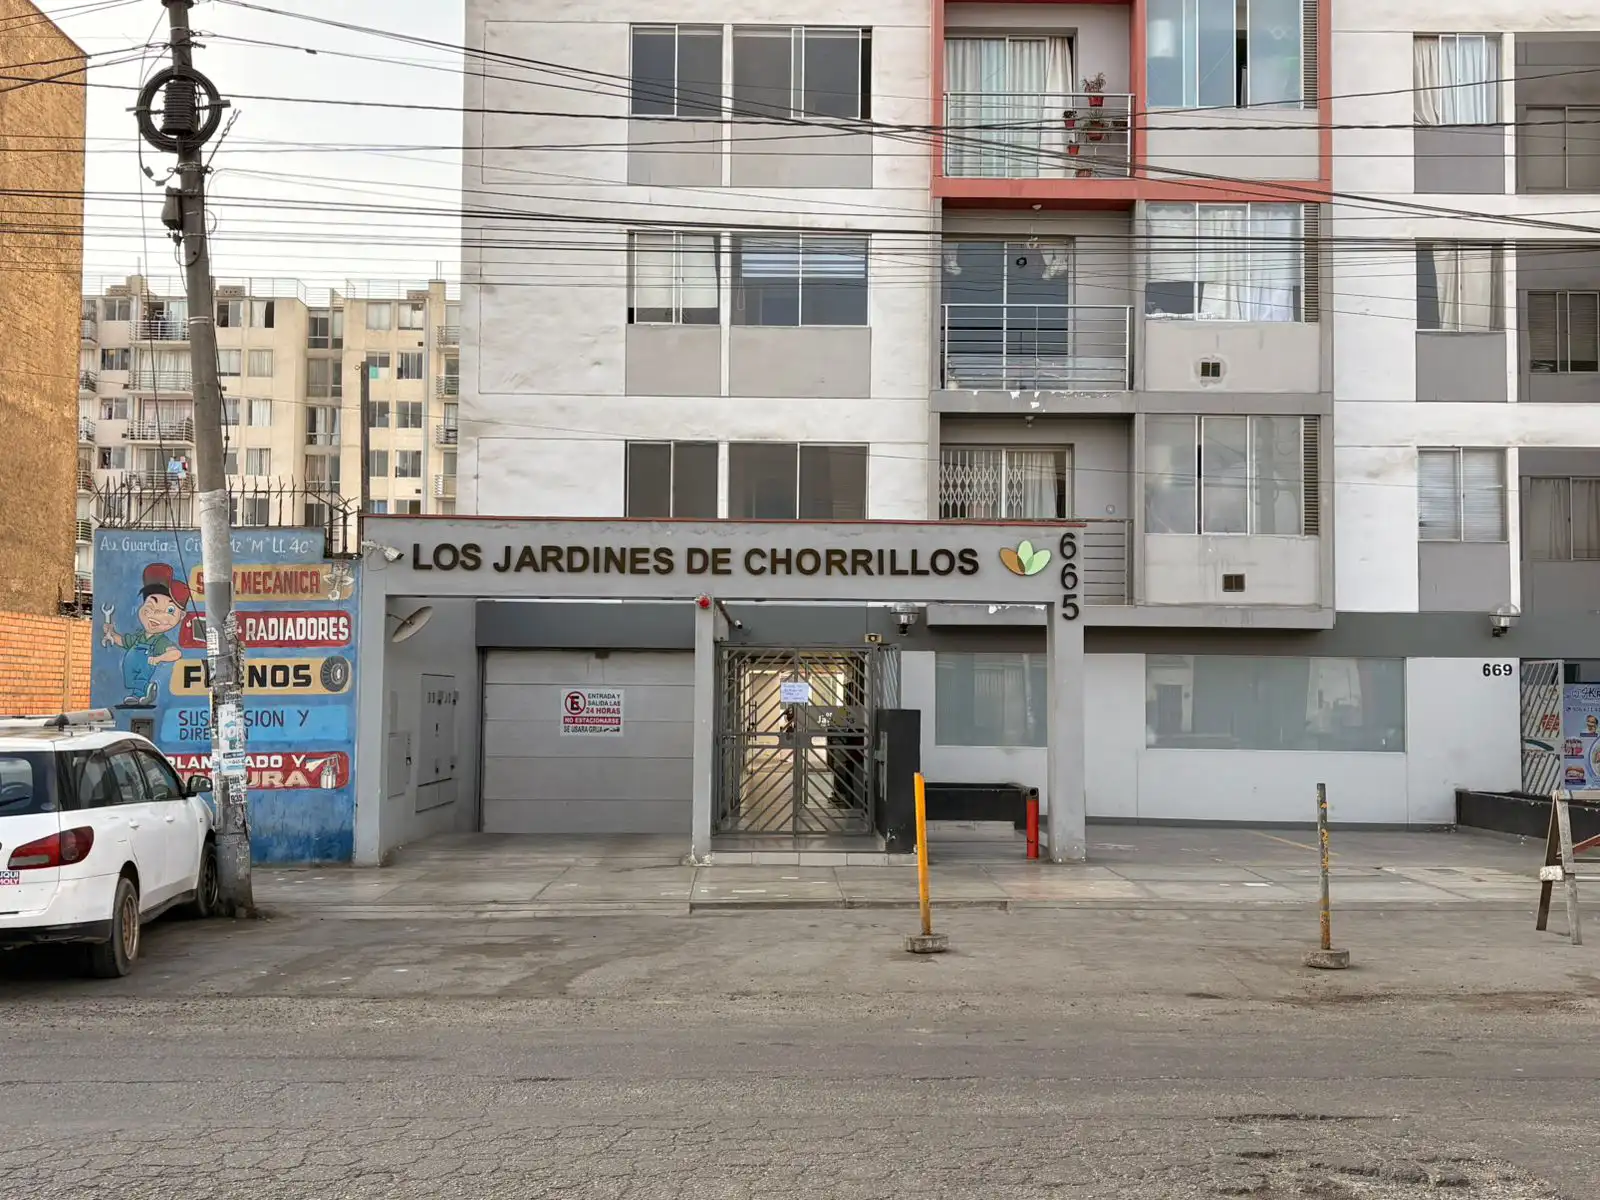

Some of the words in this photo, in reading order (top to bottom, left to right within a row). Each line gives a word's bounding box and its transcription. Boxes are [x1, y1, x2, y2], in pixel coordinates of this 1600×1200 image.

[121, 536, 168, 552] Guardia
[412, 543, 482, 571] LOS
[493, 545, 675, 575] JARDINES
[686, 547, 732, 575] DE
[744, 548, 980, 576] CHORRILLOS
[1059, 532, 1080, 621] 665
[245, 617, 349, 641] RADIADORES
[183, 664, 312, 688] FNOS
[1482, 663, 1513, 677] 669
[178, 710, 284, 728] SUSSION
[297, 709, 309, 727] Y
[596, 707, 621, 715] HORAS
[168, 755, 282, 769] PLANADO
[291, 755, 306, 767] Y
